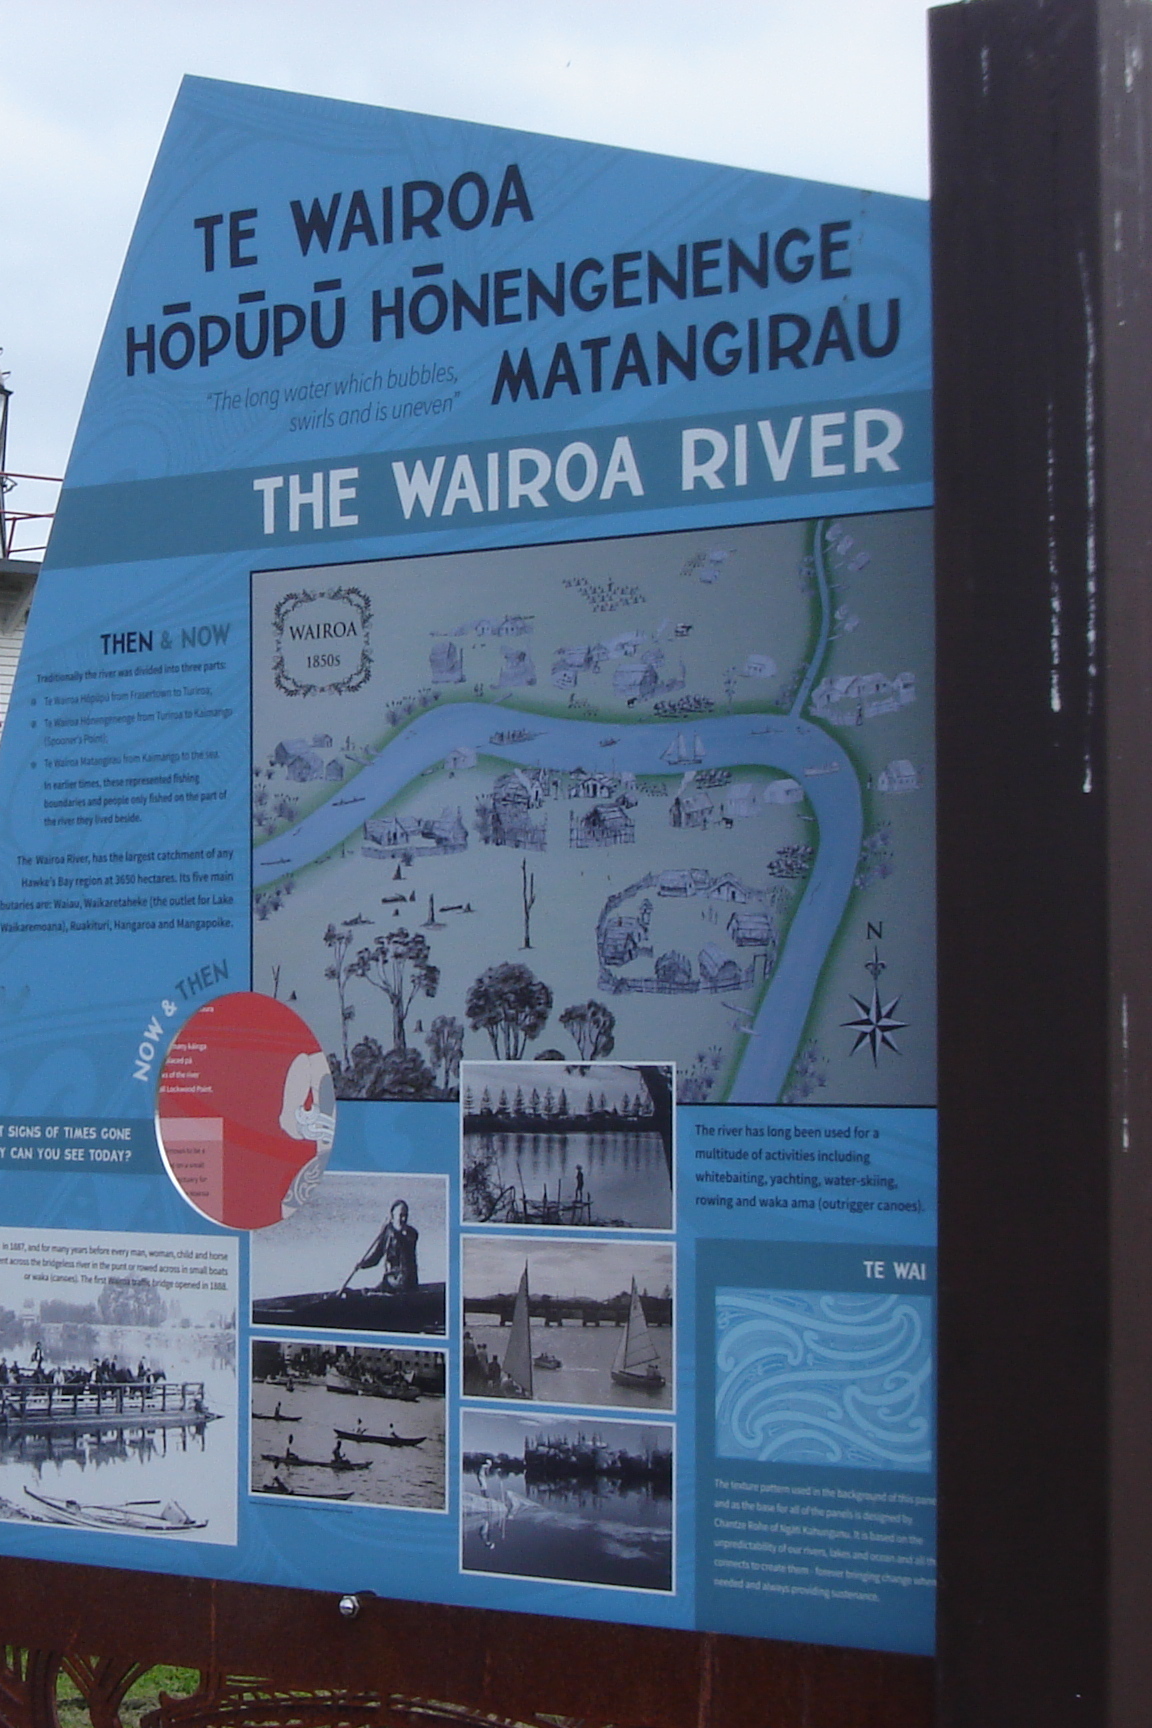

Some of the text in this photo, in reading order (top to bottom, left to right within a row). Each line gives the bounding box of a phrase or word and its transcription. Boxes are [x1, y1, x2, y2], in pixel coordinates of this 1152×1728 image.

[194, 163, 534, 274] TE WAIROA
[126, 220, 853, 377] HŌPŪPŪ HŌNENGENENGE
[491, 298, 900, 405] MATANGIRAU
[245, 388, 279, 409] long
[284, 381, 331, 402] water
[335, 371, 381, 395] which
[387, 363, 458, 389] bubbles,
[289, 409, 334, 432] swirls
[339, 403, 373, 426] and
[376, 405, 387, 421] is
[253, 408, 903, 534] THE WAIROA RIVER
[101, 623, 231, 655] THEN & NOW
[290, 622, 357, 640] WAIROA
[17, 848, 233, 865] The Wairoa River, has the largest catchment of any
[58, 876, 73, 888] Bay
[75, 876, 102, 888] region
[105, 875, 113, 884] at
[138, 873, 177, 884] hectares.
[179, 873, 190, 883] Its
[192, 872, 208, 882] five
[211, 872, 233, 882] main
[54, 899, 82, 910] Waiau,
[150, 896, 167, 908] (the
[169, 896, 196, 906] outlet
[198, 895, 210, 905] for
[212, 895, 233, 905] Lake
[867, 921, 882, 939] N
[133, 1016, 164, 1082] NOW
[162, 1000, 178, 1017] &
[175, 959, 229, 1000] THEN
[8, 1126, 41, 1138] SIGNS
[45, 1126, 59, 1138] OF
[64, 1127, 96, 1139] TIMES
[101, 1128, 131, 1140] GONE
[695, 1125, 879, 1140] The river has long been used for a
[10, 1148, 32, 1159] CAN
[37, 1148, 60, 1160] YOU
[64, 1149, 84, 1160] SEE
[89, 1149, 131, 1162] TODAY?
[695, 1149, 870, 1165] multitude of activities including
[695, 1171, 898, 1189] whitebaiting, yachting, water-skiing,
[695, 1196, 925, 1213] rowing and waka ama (outrigger canoes).
[863, 1261, 926, 1280] TE WAI
